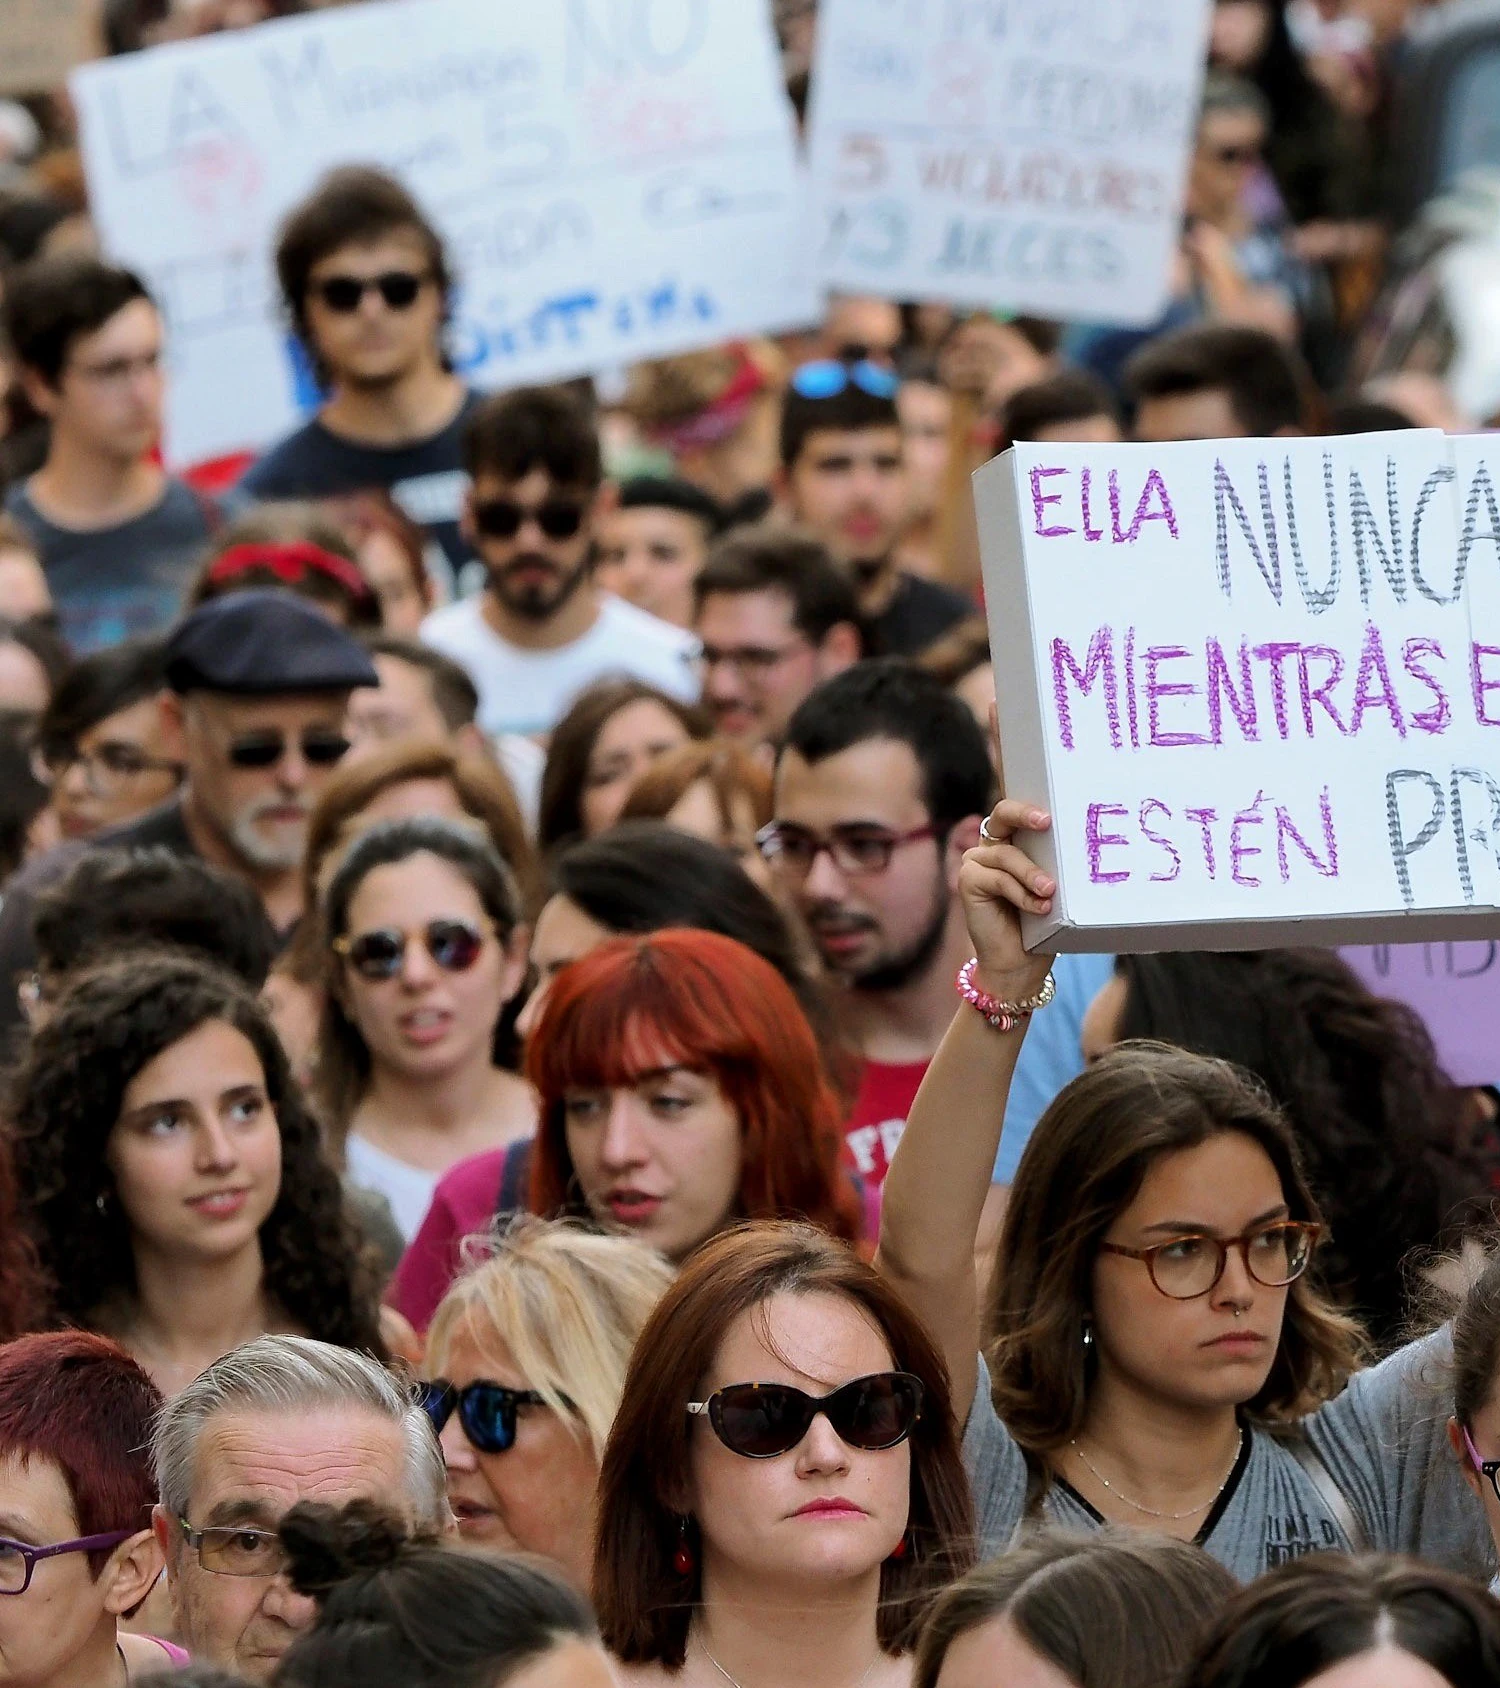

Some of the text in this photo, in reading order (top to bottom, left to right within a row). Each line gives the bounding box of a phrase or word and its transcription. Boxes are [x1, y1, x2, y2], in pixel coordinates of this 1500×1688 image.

[1027, 463, 1180, 545] ELLA
[1049, 618, 1455, 752] MIENTRAS
[1085, 784, 1341, 888] ESTÉN
